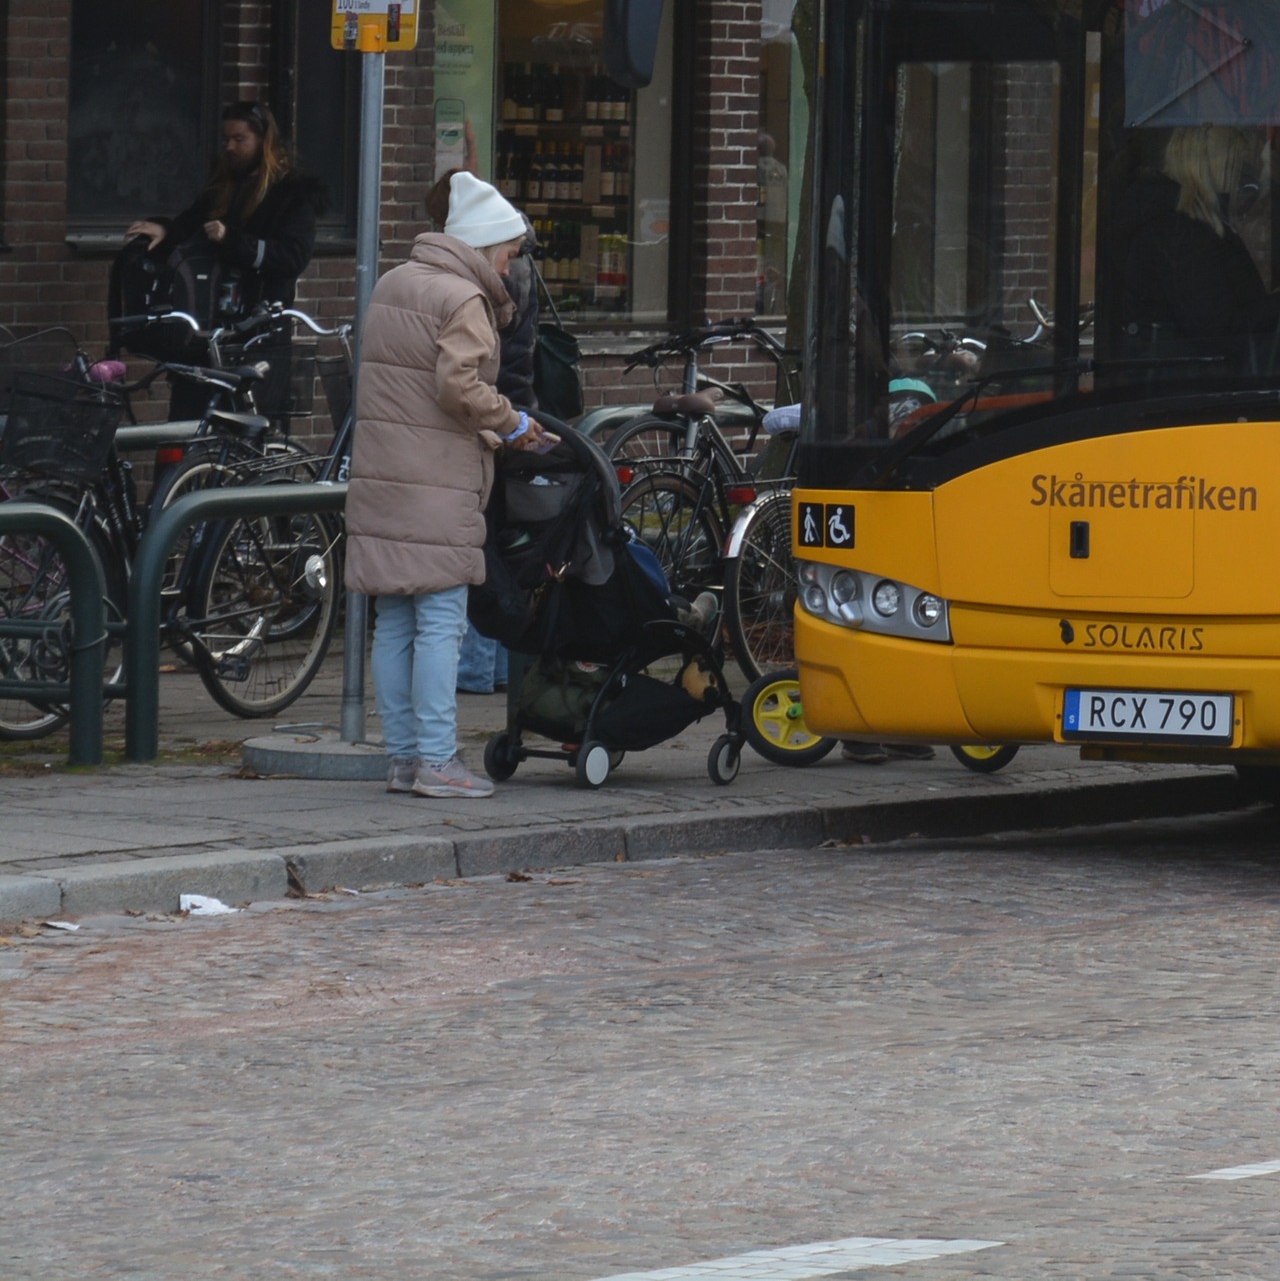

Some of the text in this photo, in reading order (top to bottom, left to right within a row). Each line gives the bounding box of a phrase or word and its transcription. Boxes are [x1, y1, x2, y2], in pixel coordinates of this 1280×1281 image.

[1030, 472, 1257, 511] Skånetrafiken
[1083, 623, 1204, 651] SOLARIS
[1090, 696, 1217, 731] RCX 790
